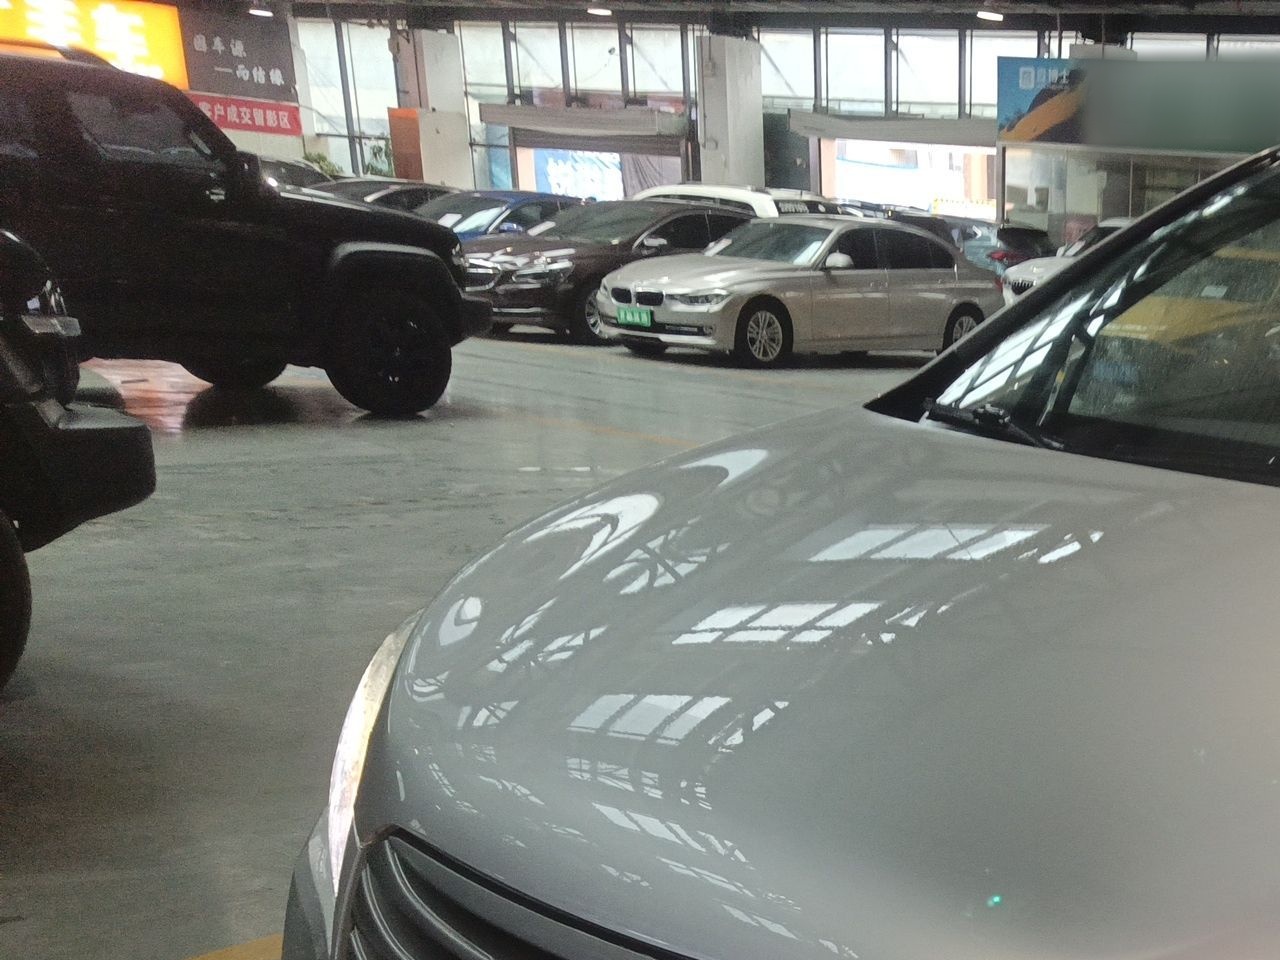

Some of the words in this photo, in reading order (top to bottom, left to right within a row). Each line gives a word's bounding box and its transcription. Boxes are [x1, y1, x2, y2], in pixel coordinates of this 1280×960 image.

[199, 101, 291, 129] 客户成交留影区
